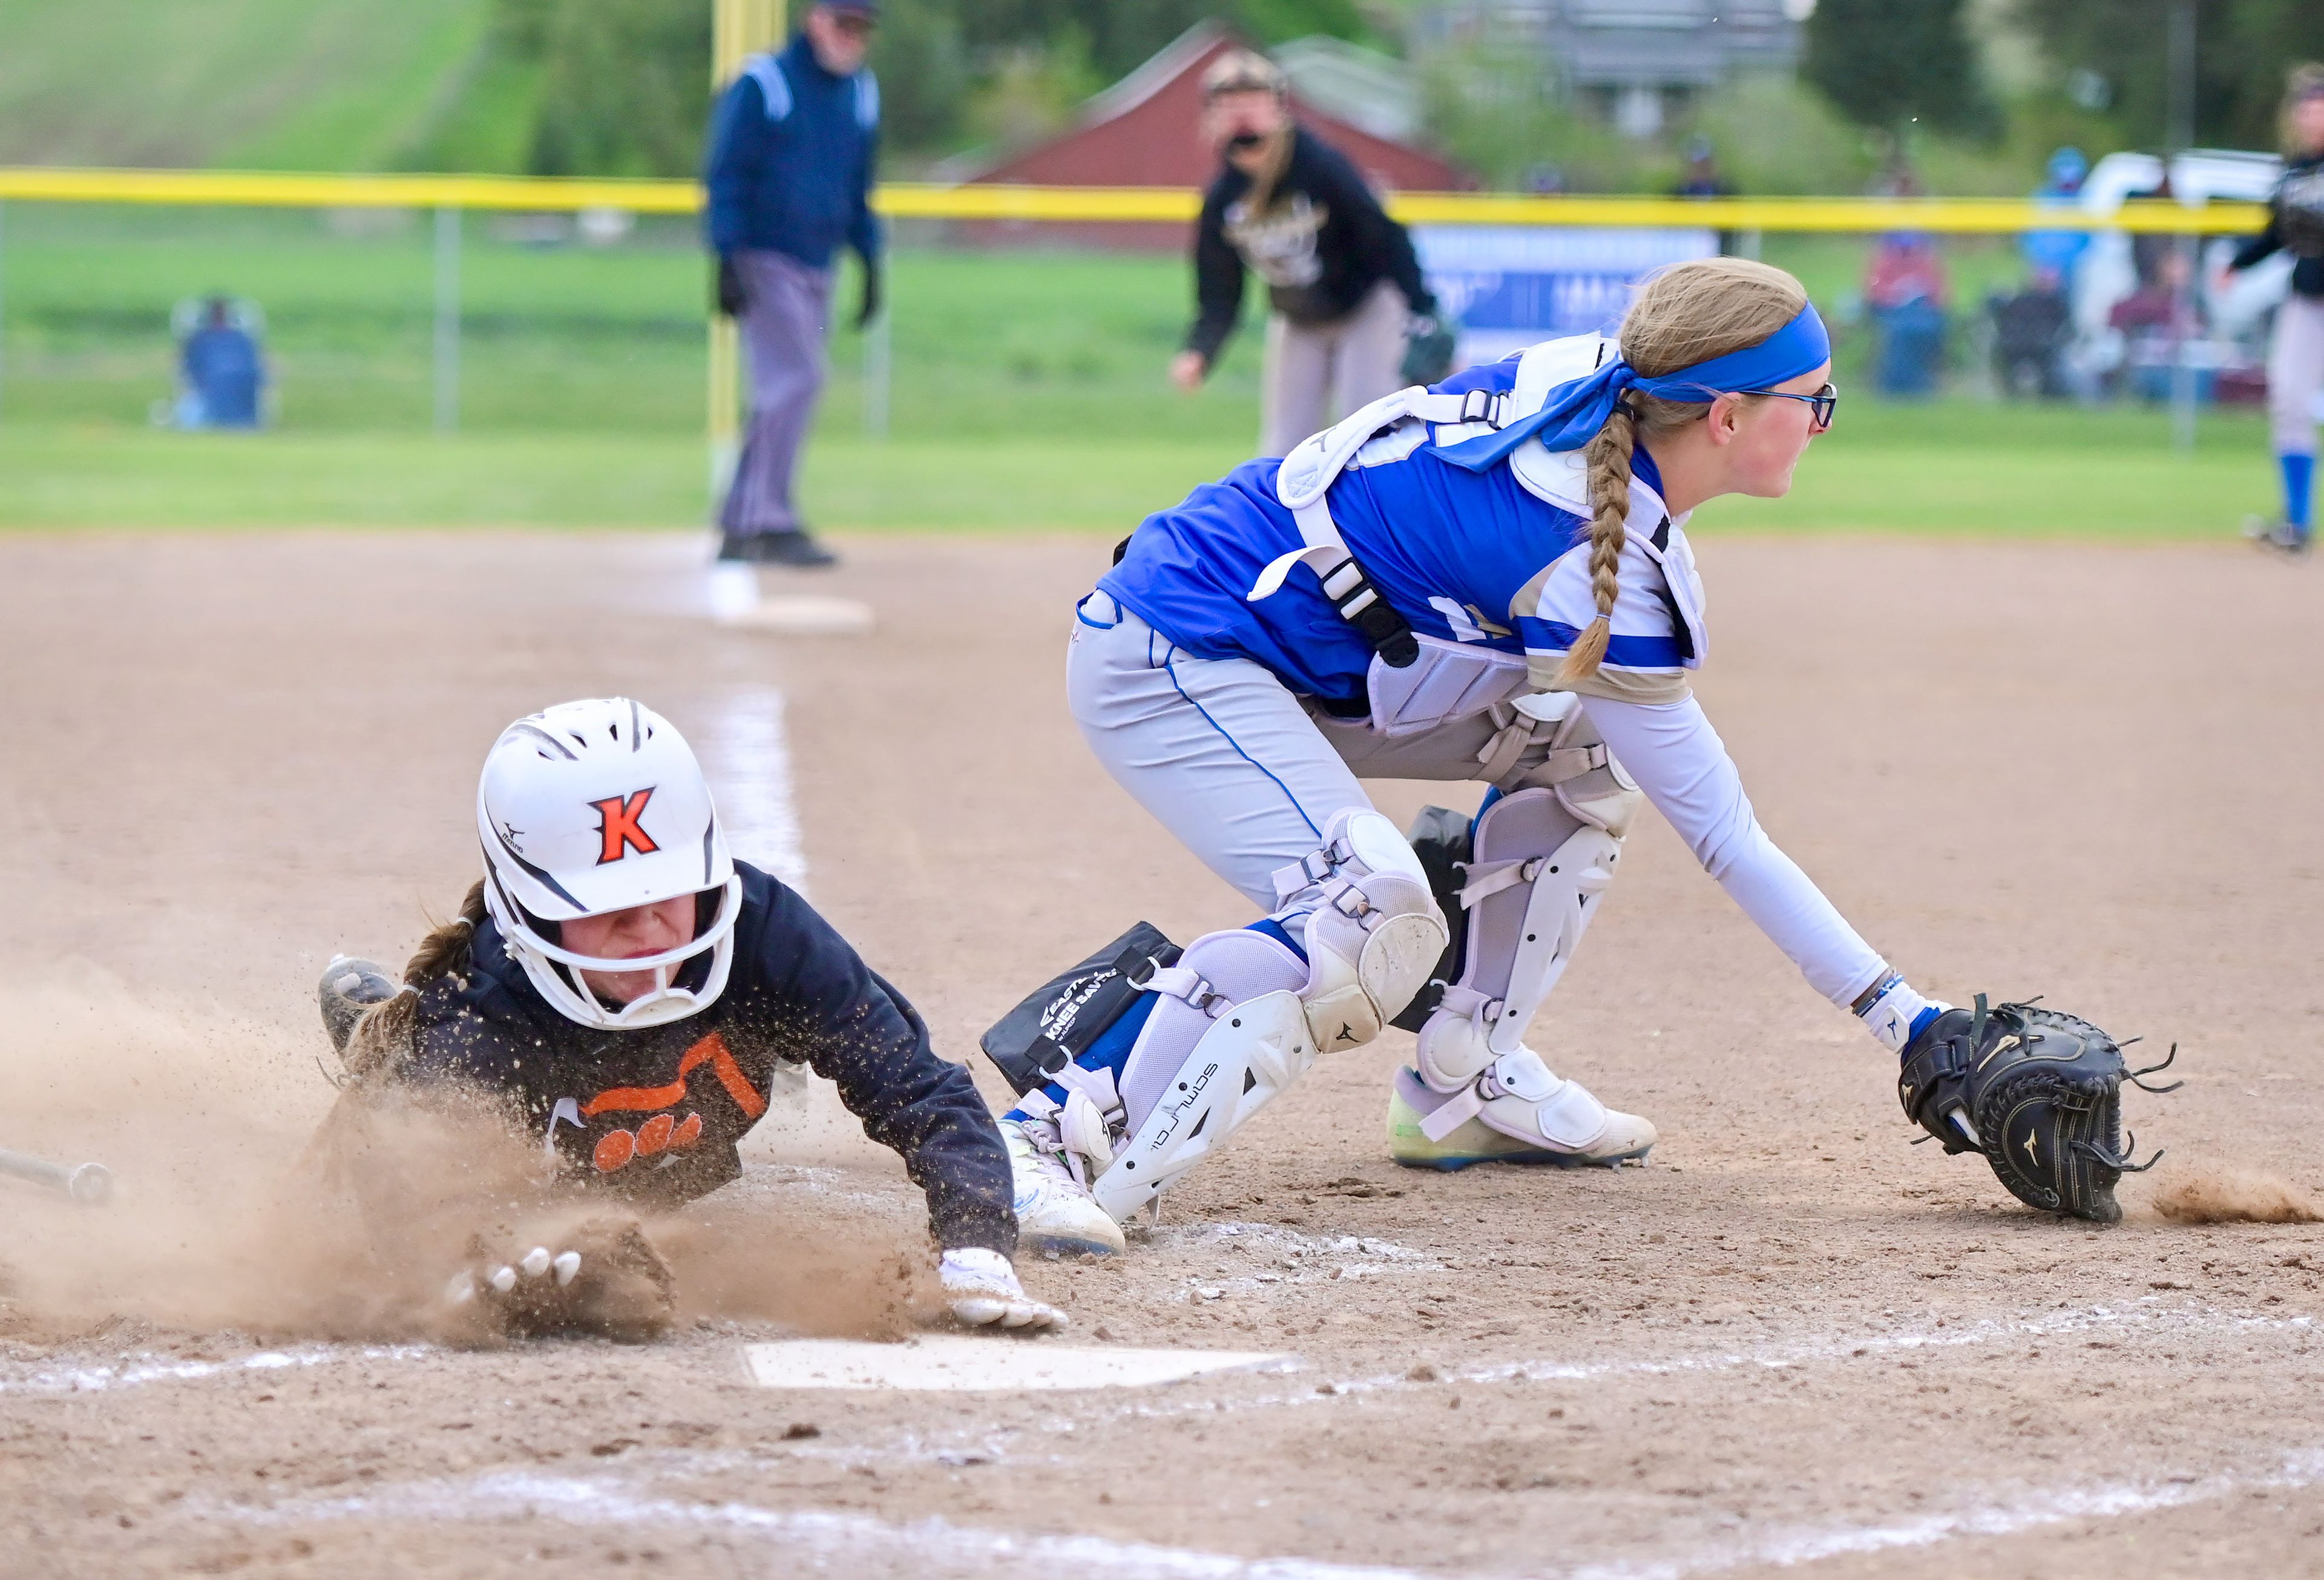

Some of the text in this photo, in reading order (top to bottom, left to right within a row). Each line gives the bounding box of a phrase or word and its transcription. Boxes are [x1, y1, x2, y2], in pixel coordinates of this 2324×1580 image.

[586, 785, 661, 866] K
[1049, 971, 1098, 1015] EAST
[1045, 1002, 1080, 1041] KNEE
